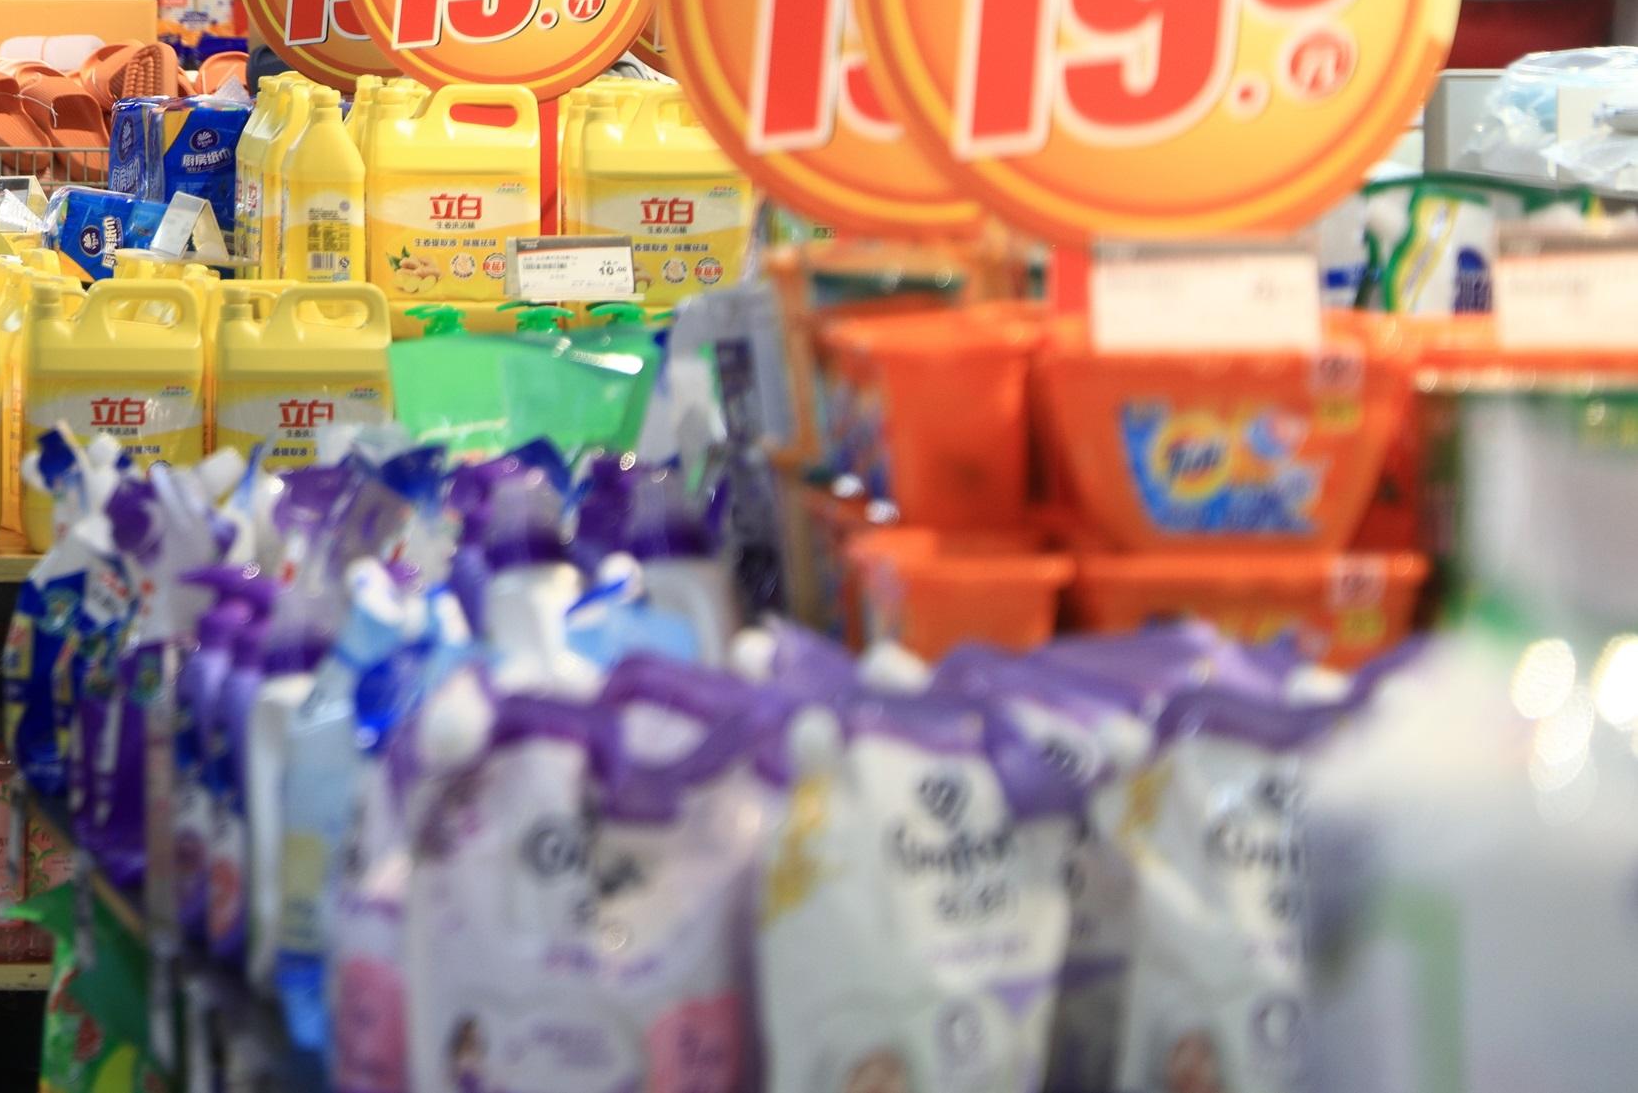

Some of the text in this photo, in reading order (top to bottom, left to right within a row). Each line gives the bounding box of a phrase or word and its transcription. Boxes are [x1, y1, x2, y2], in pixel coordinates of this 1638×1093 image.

[182, 147, 232, 167] 厨房纸巾
[429, 193, 482, 220] 立白
[640, 197, 695, 225] 立白
[90, 397, 146, 426] 立白
[278, 398, 334, 428] 立白
